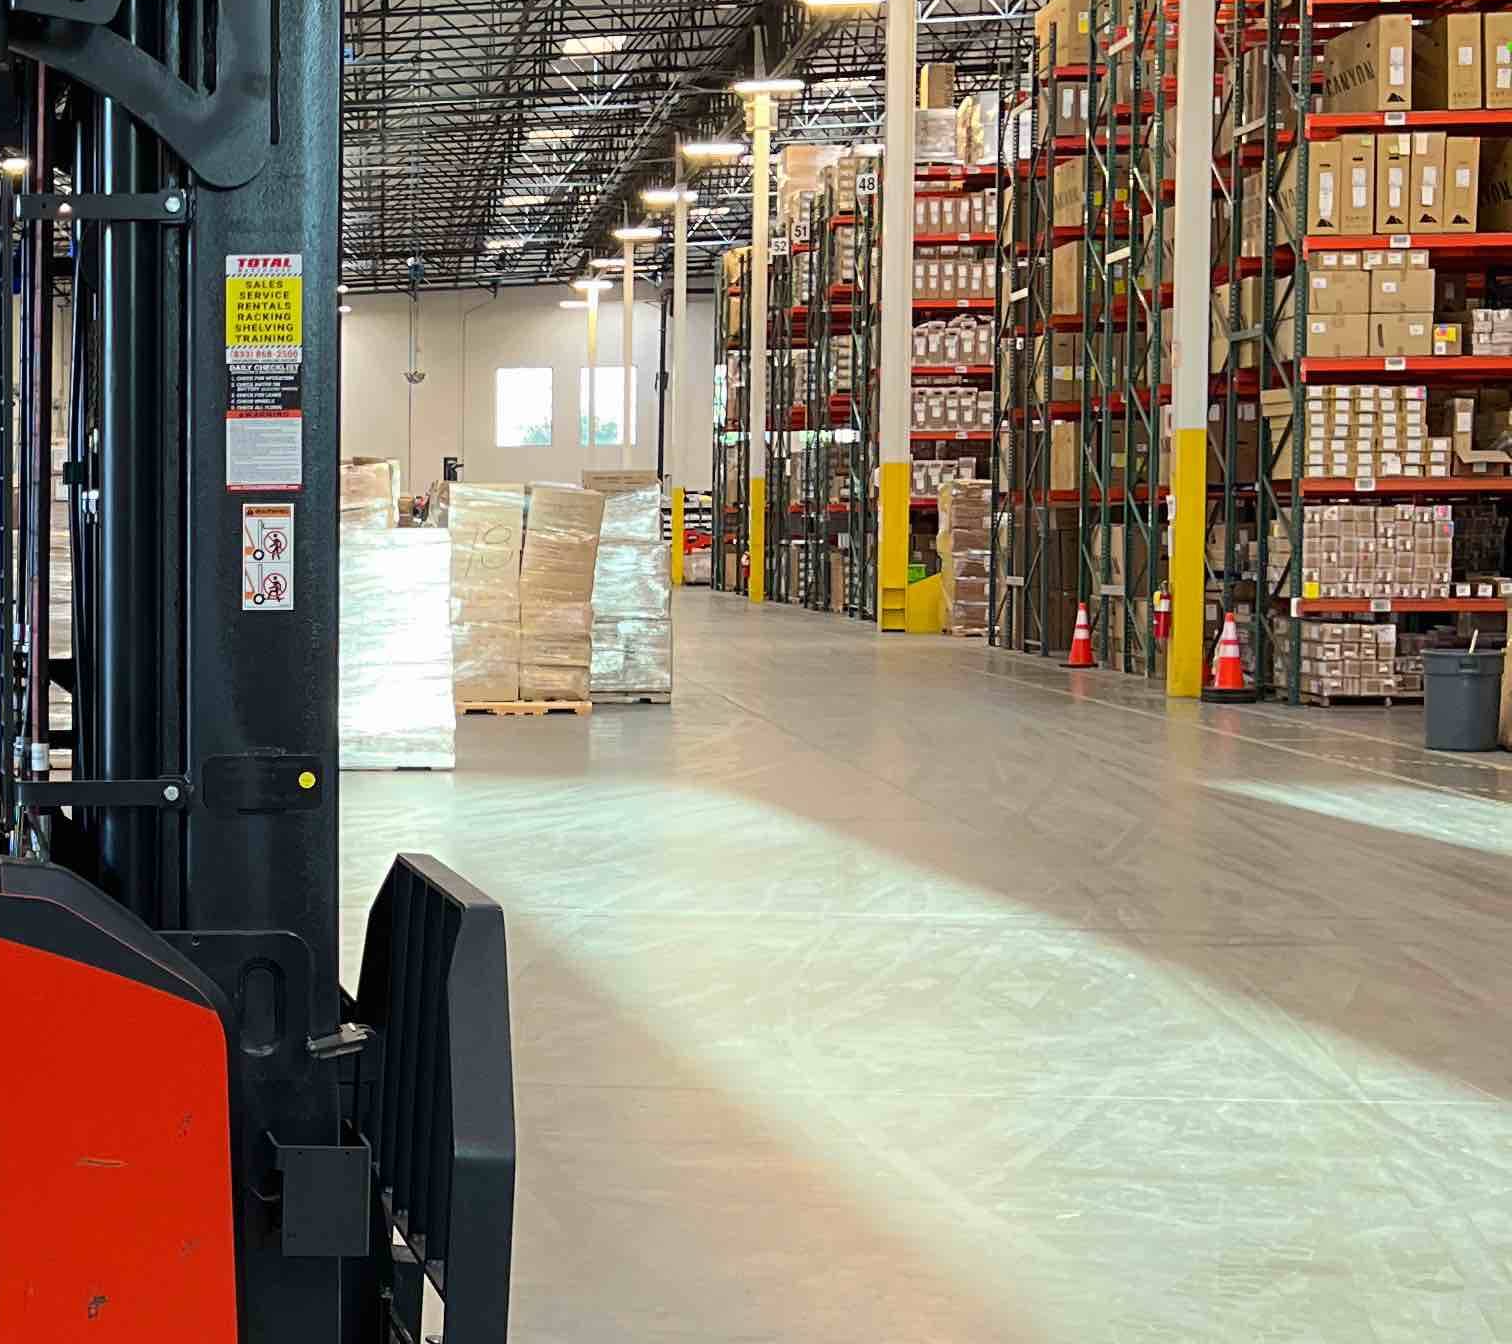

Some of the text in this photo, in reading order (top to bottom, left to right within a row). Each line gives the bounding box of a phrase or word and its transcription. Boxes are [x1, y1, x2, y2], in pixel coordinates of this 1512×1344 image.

[1326, 61, 1376, 97] CANYON
[858, 176, 876, 191] 48
[794, 224, 808, 237] 51
[773, 240, 787, 252] 52
[237, 258, 293, 268] TOTAL
[245, 280, 284, 289] SALES
[239, 291, 290, 300] SERVICE
[237, 302, 292, 311] RENTALS
[237, 313, 292, 321] RACKING
[235, 323, 294, 332] SHELVING
[235, 334, 294, 343] TRAINING
